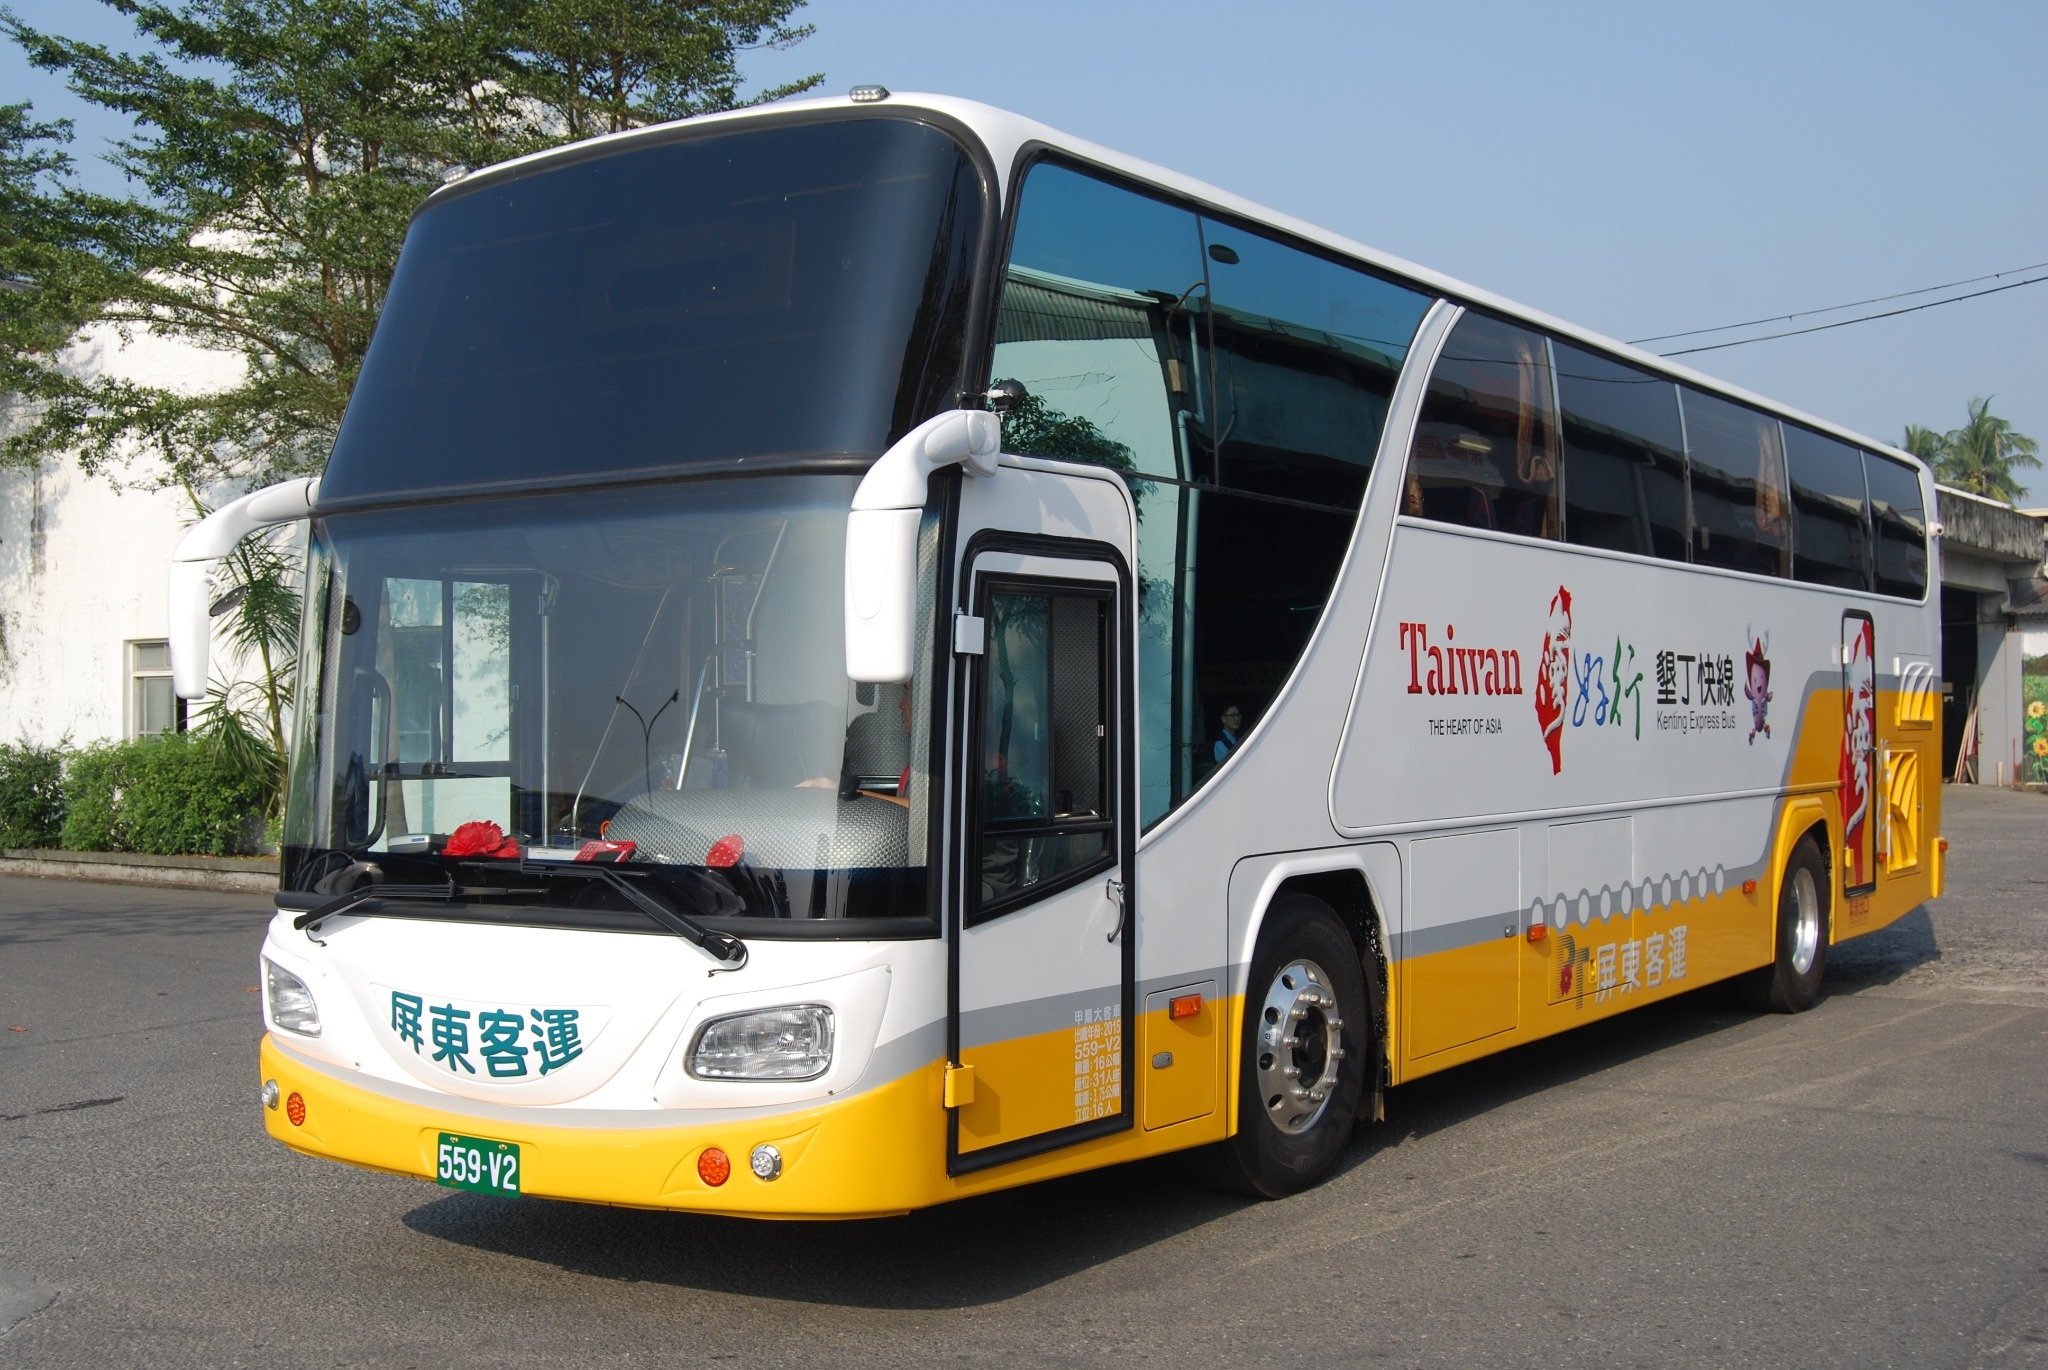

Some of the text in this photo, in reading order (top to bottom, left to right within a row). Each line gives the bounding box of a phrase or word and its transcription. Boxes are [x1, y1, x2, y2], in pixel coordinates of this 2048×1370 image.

[1399, 622, 1523, 697] Taiwan
[1656, 650, 1735, 707] 墾丁快線
[1428, 718, 1503, 736] THE HEART OF ASIA
[1657, 710, 1736, 735] Kenting Express Bus
[1595, 925, 1687, 1006] 屏東客運
[391, 990, 583, 1078] 屏東客運
[1074, 1036, 1121, 1060] 559-V2
[438, 1143, 517, 1192] 559-V2
